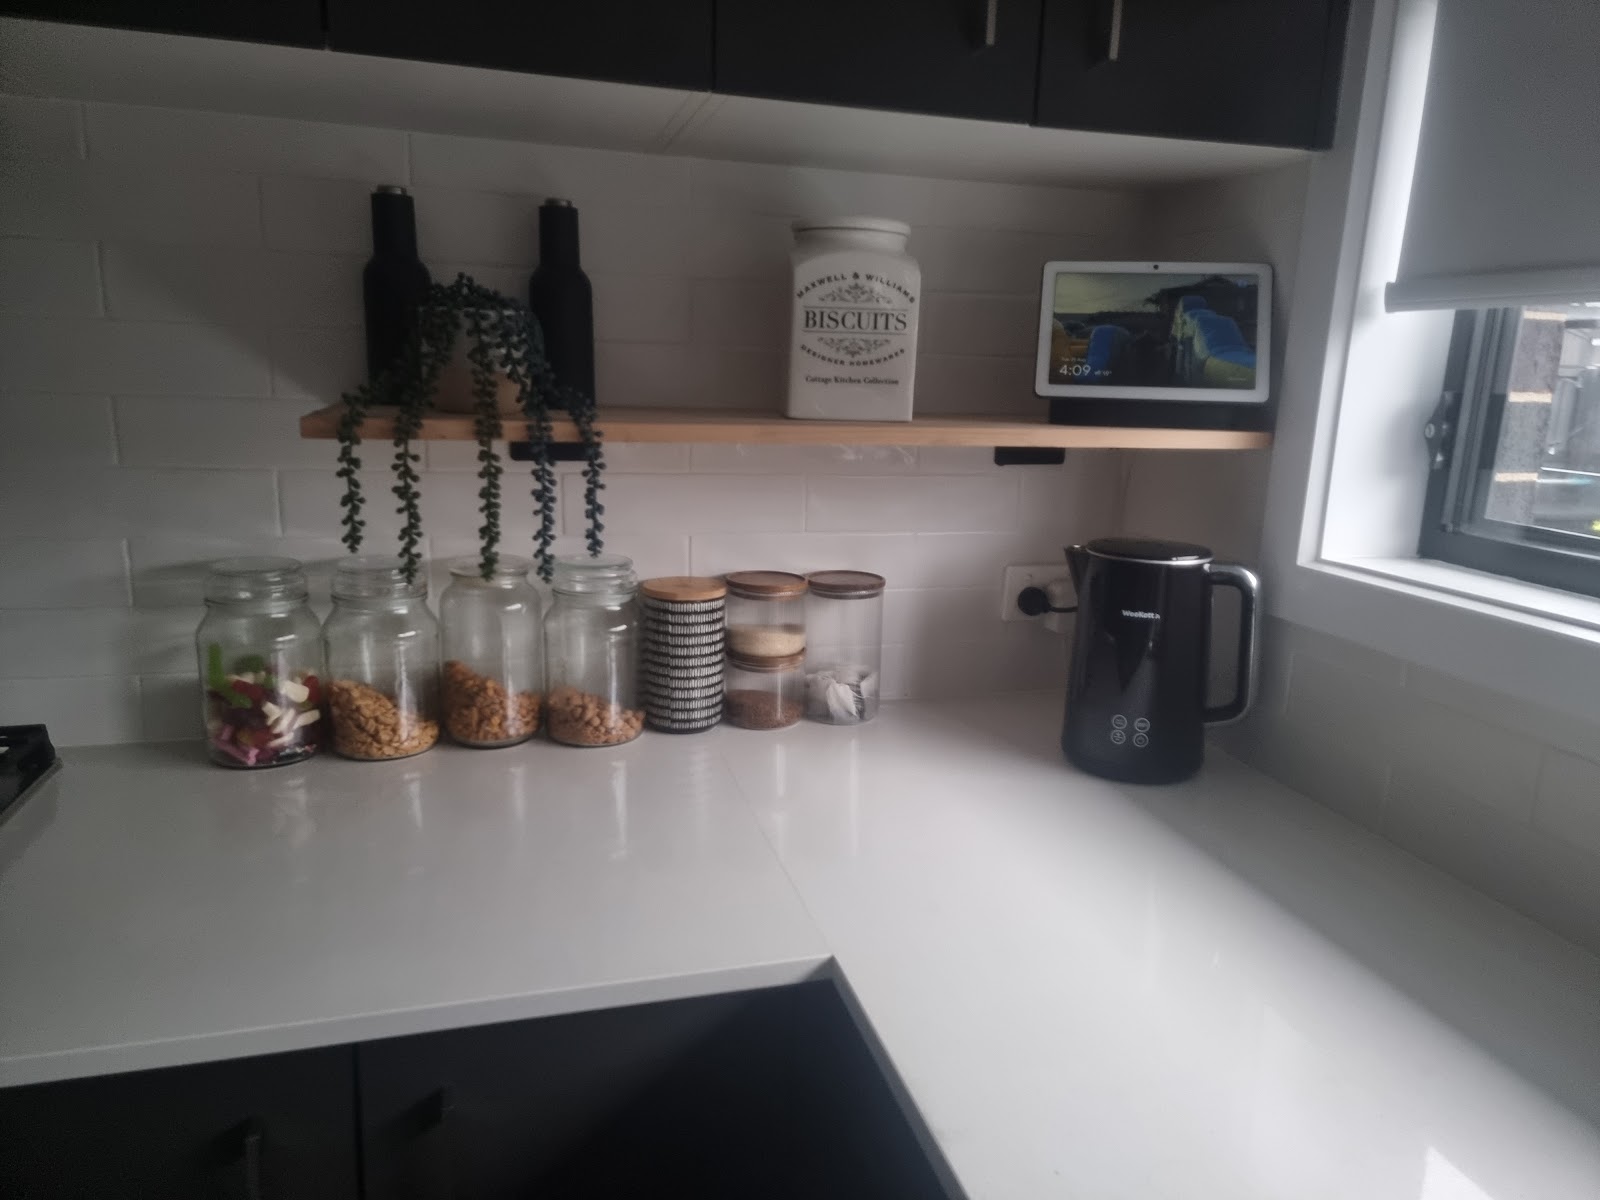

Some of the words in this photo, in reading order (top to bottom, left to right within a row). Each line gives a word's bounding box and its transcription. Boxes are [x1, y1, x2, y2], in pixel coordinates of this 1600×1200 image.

[796, 273, 847, 299] MAXWELL
[851, 271, 860, 280] &
[865, 273, 915, 304] WILLIAMS
[804, 310, 908, 331] BISCUITS
[800, 344, 845, 366] DESIGNER
[849, 348, 905, 366] HOMEWARES
[805, 375, 832, 385] Cottage
[834, 376, 862, 385] Kitchen
[863, 377, 900, 385] Collection
[1059, 364, 1091, 376] 4:09
